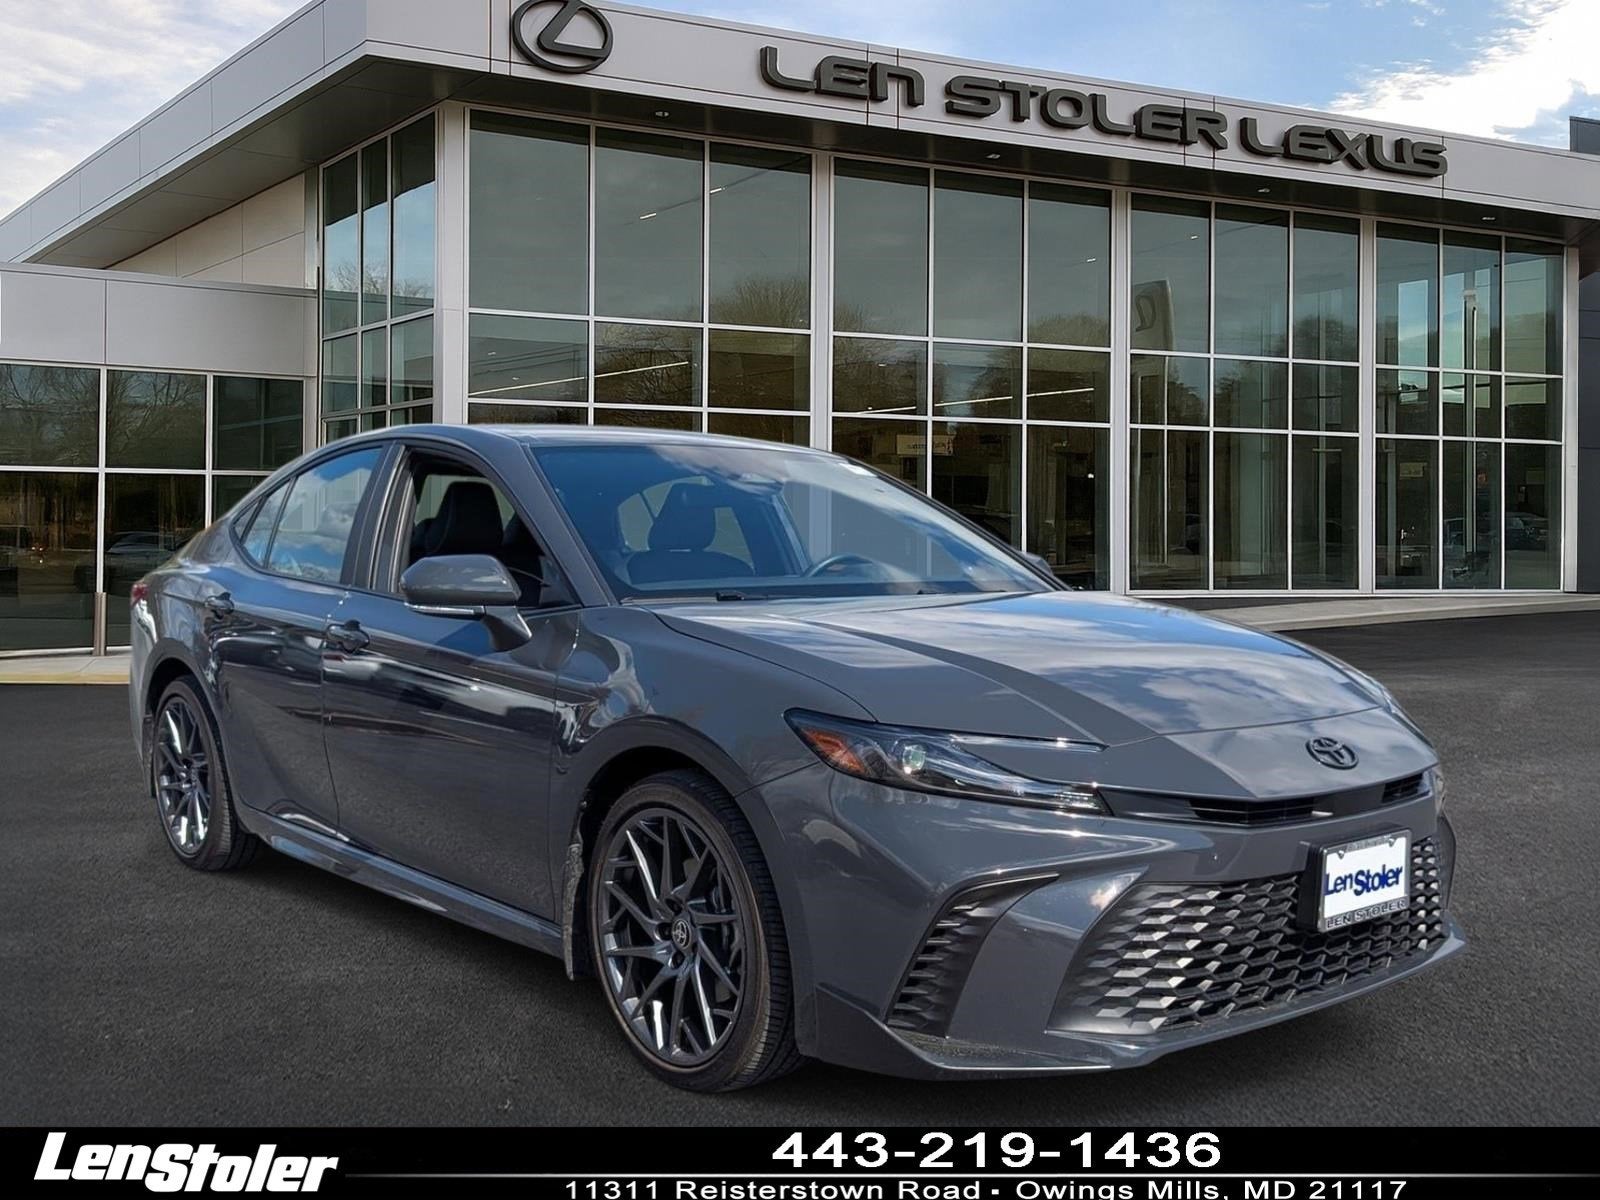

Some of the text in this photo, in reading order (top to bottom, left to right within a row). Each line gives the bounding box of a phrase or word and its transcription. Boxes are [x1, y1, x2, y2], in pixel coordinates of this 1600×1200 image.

[759, 45, 1449, 178] LEN STOLER LEXUS
[1324, 864, 1403, 896] LenStoler
[1326, 898, 1407, 929] LEN STOLER
